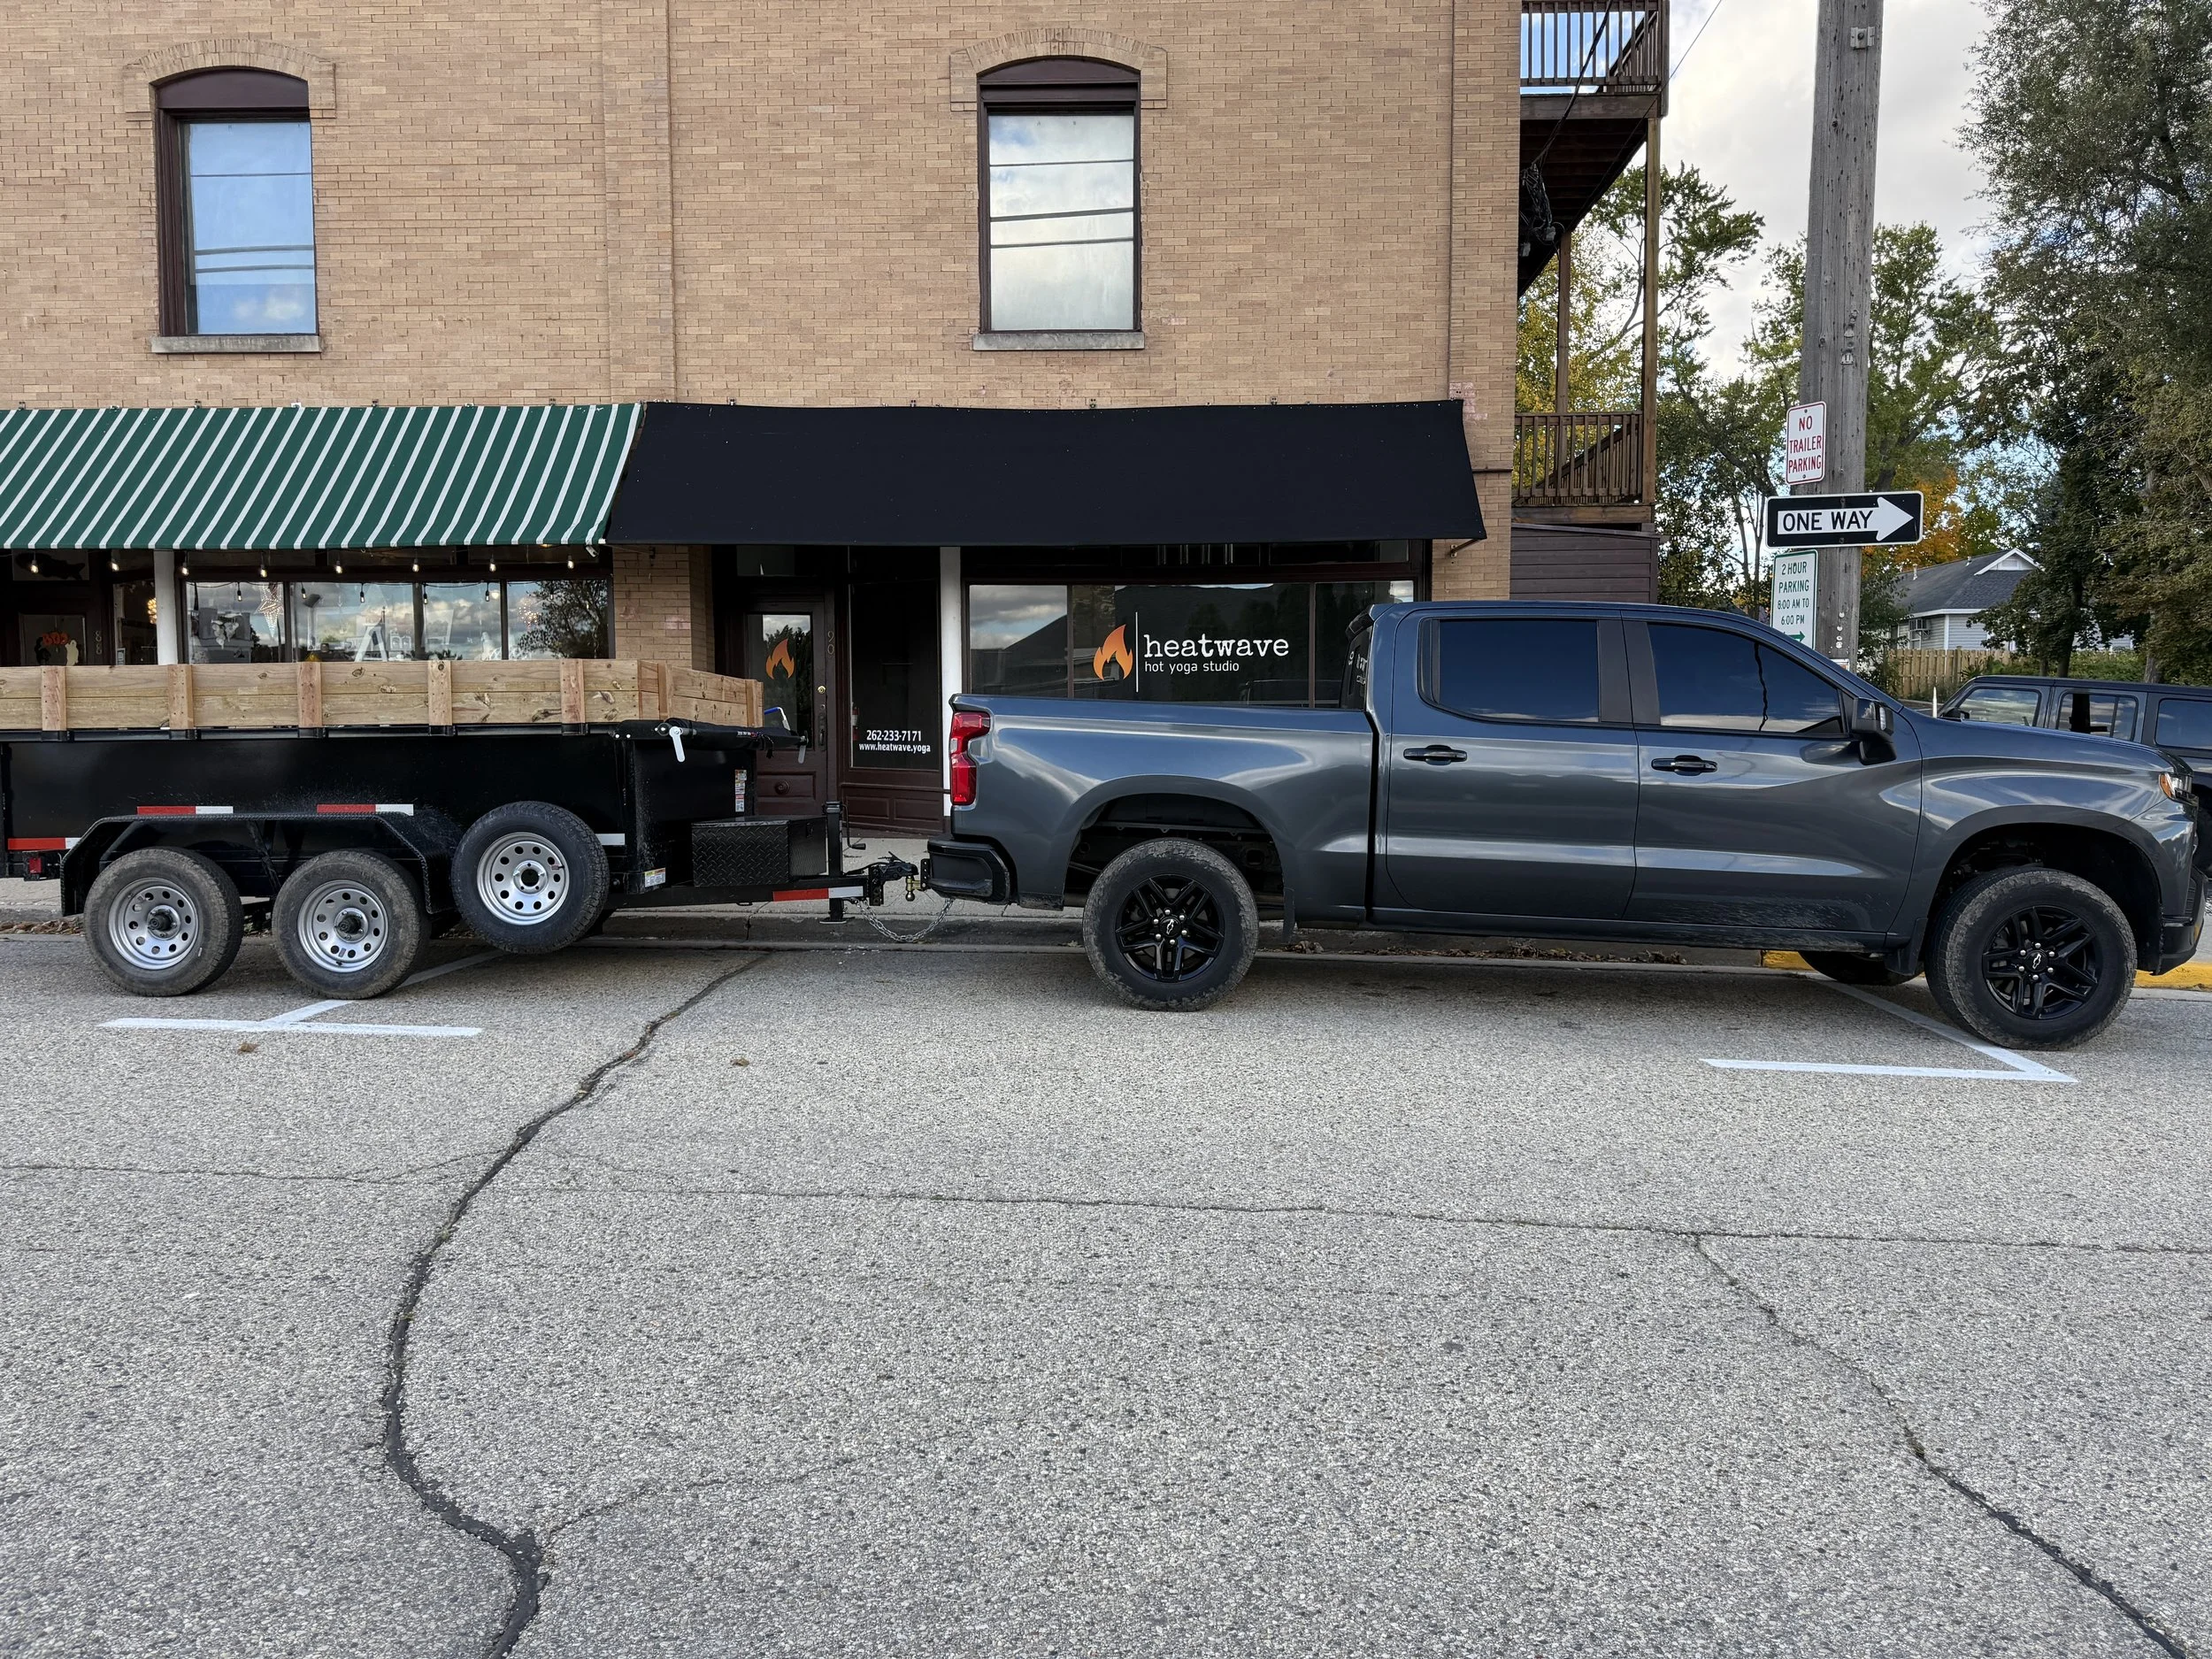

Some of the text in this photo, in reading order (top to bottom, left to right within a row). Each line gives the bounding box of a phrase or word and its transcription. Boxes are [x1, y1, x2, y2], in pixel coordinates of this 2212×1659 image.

[1799, 415, 1813, 432] NO
[1789, 434, 1822, 454] TRAILER
[1788, 455, 1822, 474] PARKING
[1783, 510, 1874, 532] ONE WAY
[1781, 561, 1808, 576] 2 HOUR
[1778, 580, 1809, 594] PARKING
[1777, 597, 1809, 611] 8:00 AM TO
[1780, 614, 1805, 626] 6:00 PM
[827, 630, 835, 655] 90
[1143, 633, 1289, 657] heatwave
[1144, 661, 1240, 675] hot yoga studio
[858, 741, 931, 754] www.heatwave.yoga
